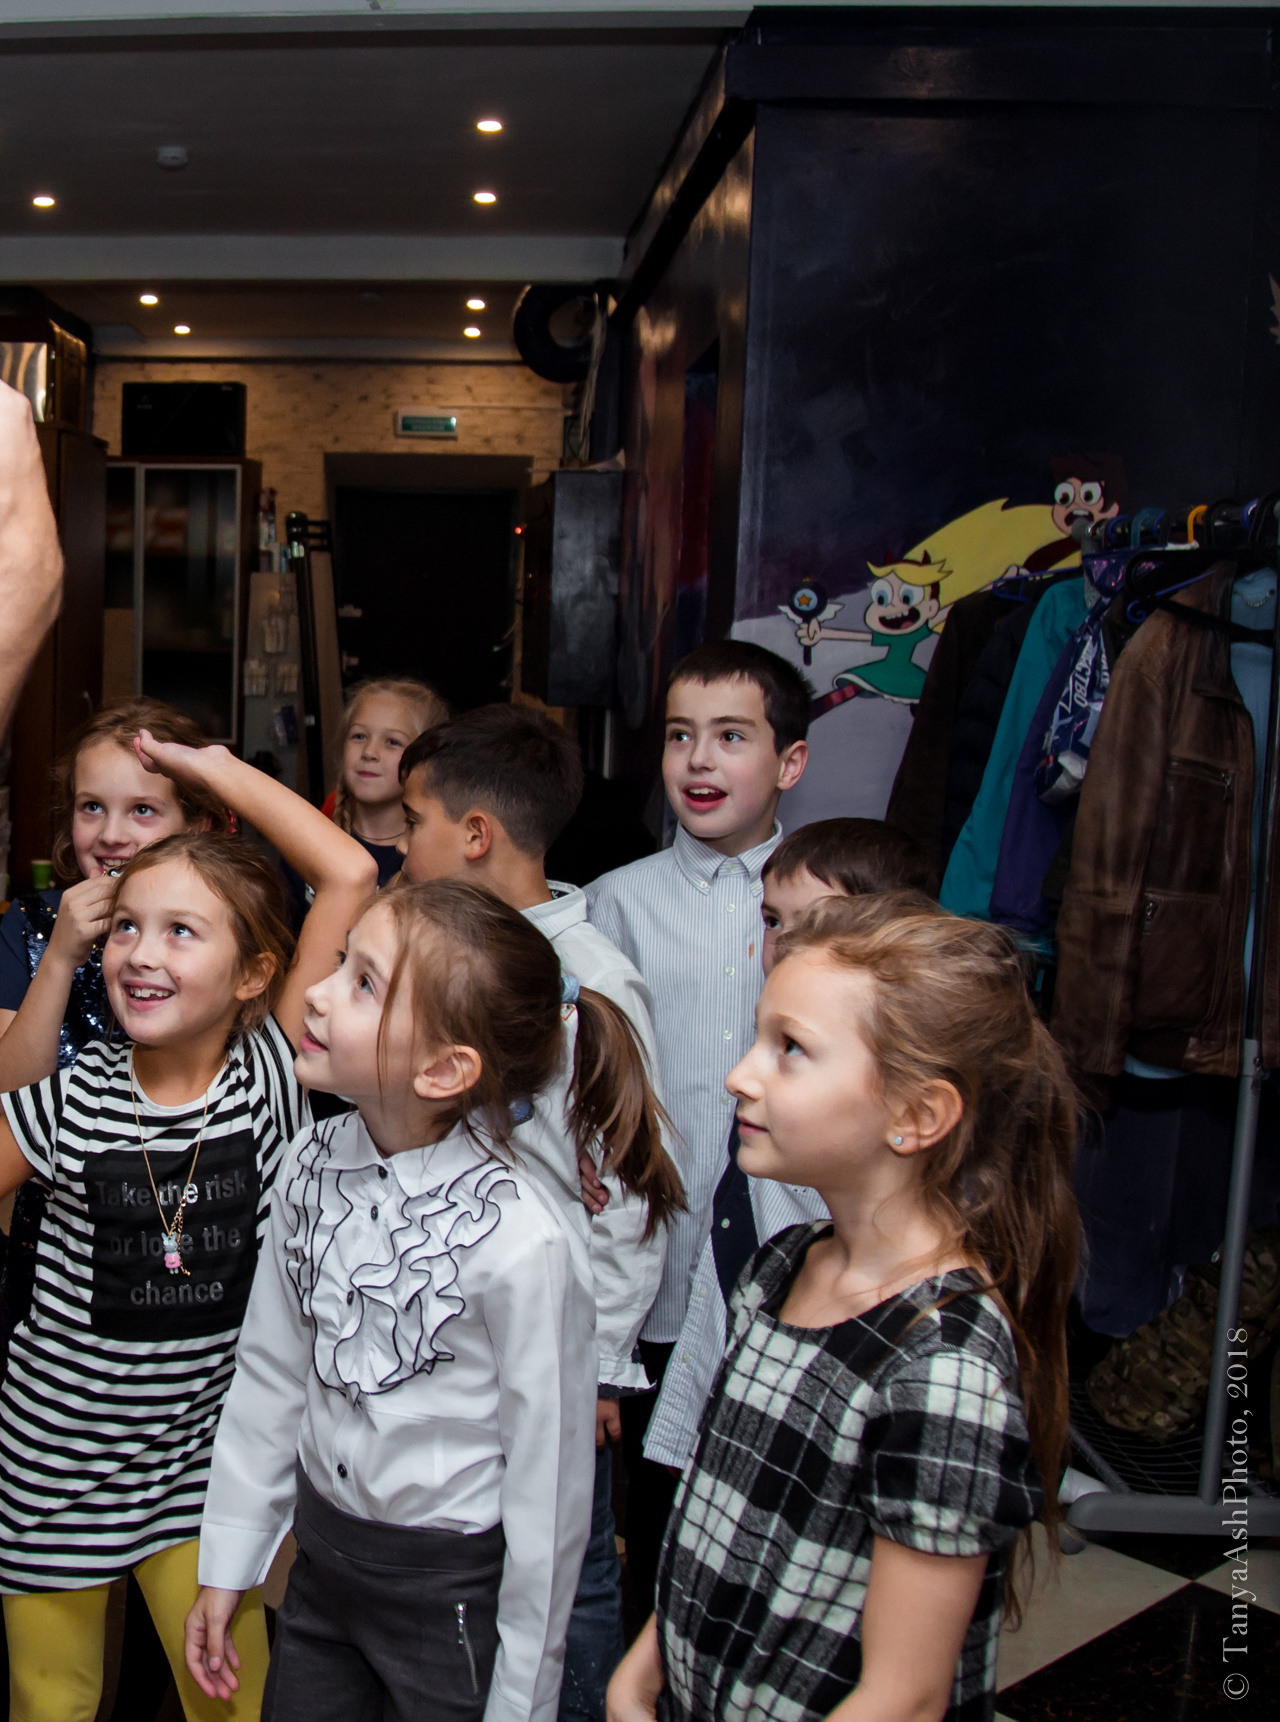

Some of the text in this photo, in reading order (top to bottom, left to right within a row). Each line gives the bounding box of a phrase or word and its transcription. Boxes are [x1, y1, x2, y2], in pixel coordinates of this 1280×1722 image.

[95, 1168, 247, 1208] Take the risk
[110, 1225, 241, 1257] or loe the
[130, 1280, 224, 1306] chance
